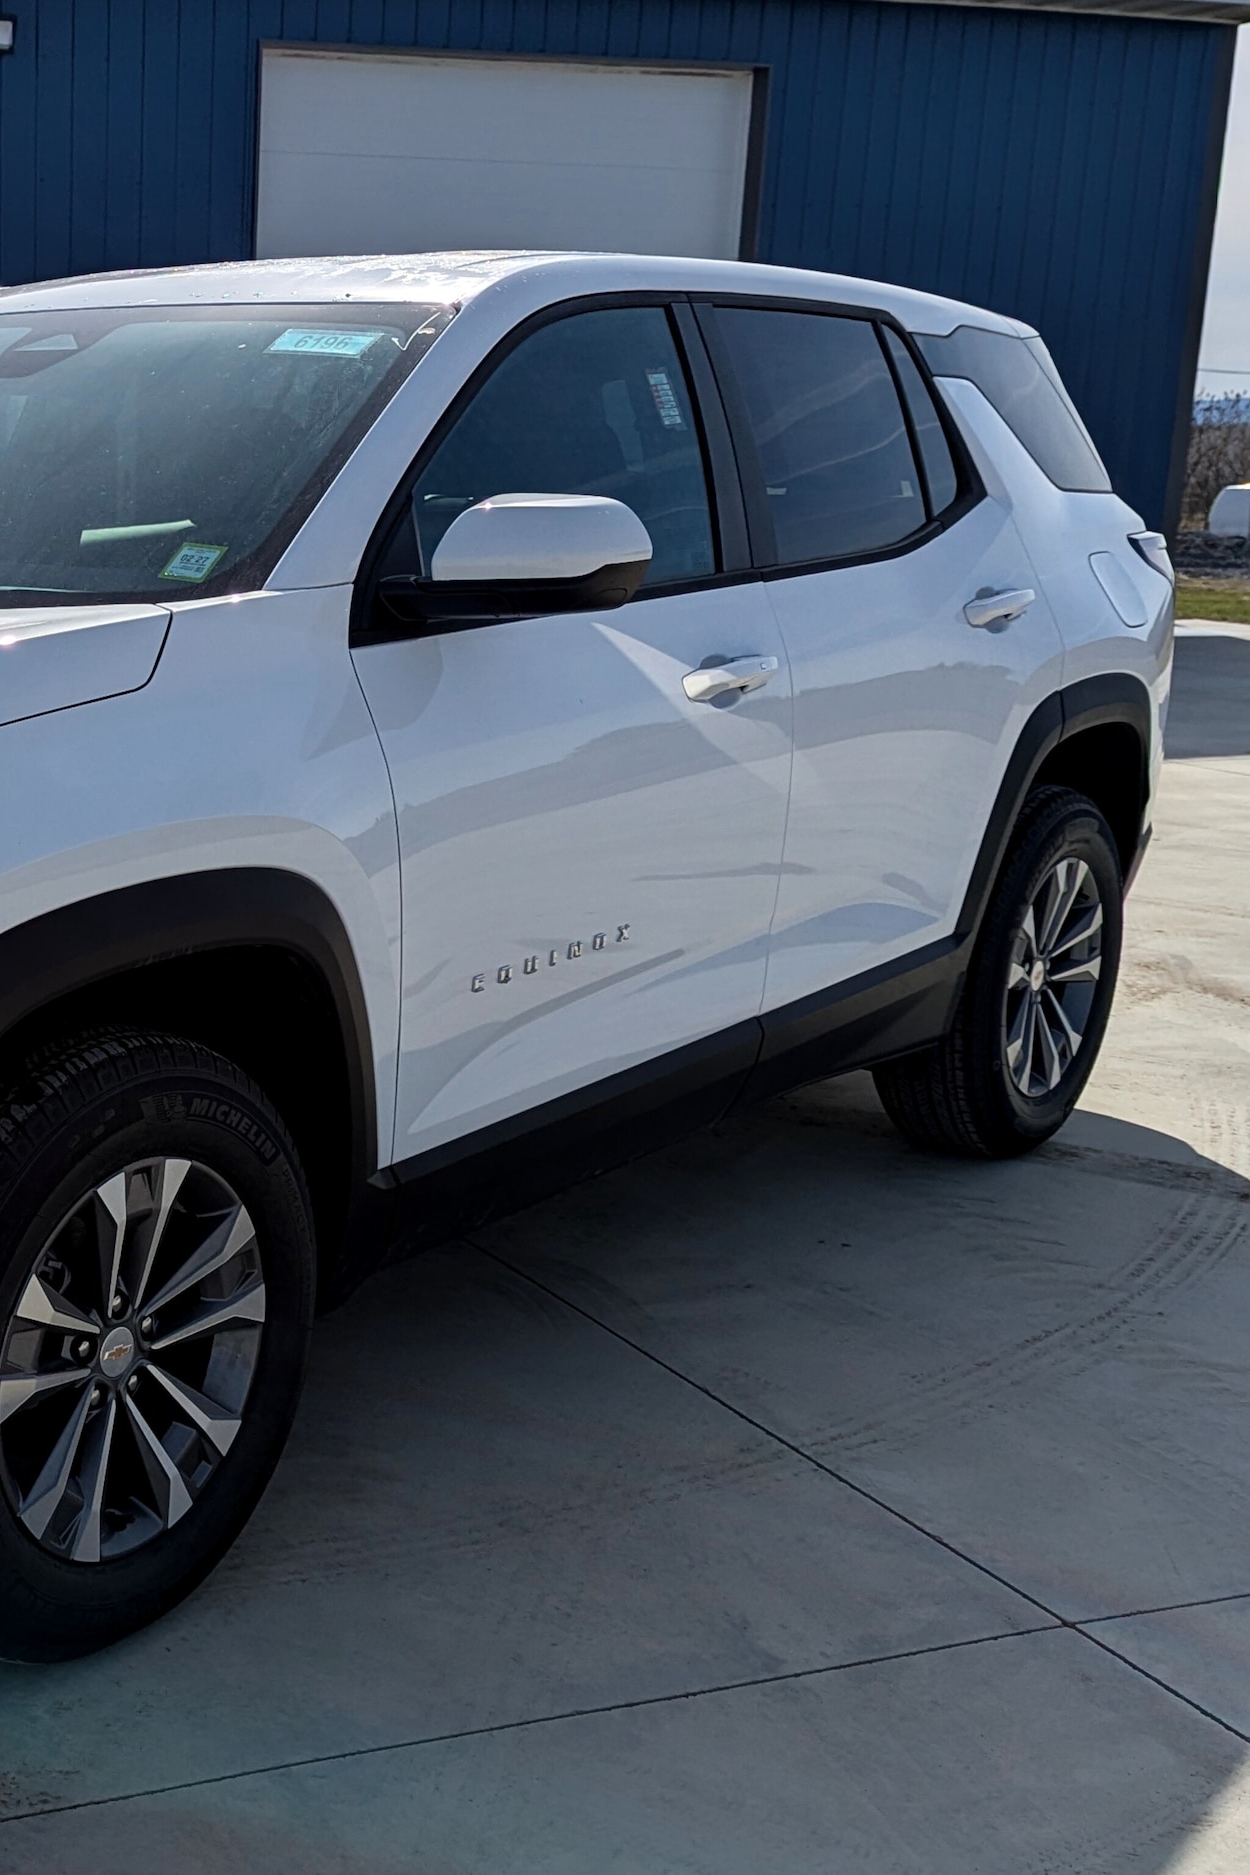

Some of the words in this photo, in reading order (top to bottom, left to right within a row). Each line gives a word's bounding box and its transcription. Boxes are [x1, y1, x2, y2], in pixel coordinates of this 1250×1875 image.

[293, 335, 353, 350] 6196
[181, 554, 195, 562] 02
[471, 923, 630, 992] EQUINOX
[189, 1097, 277, 1159] MICHELIN
[281, 1168, 307, 1233] PRIMACY
